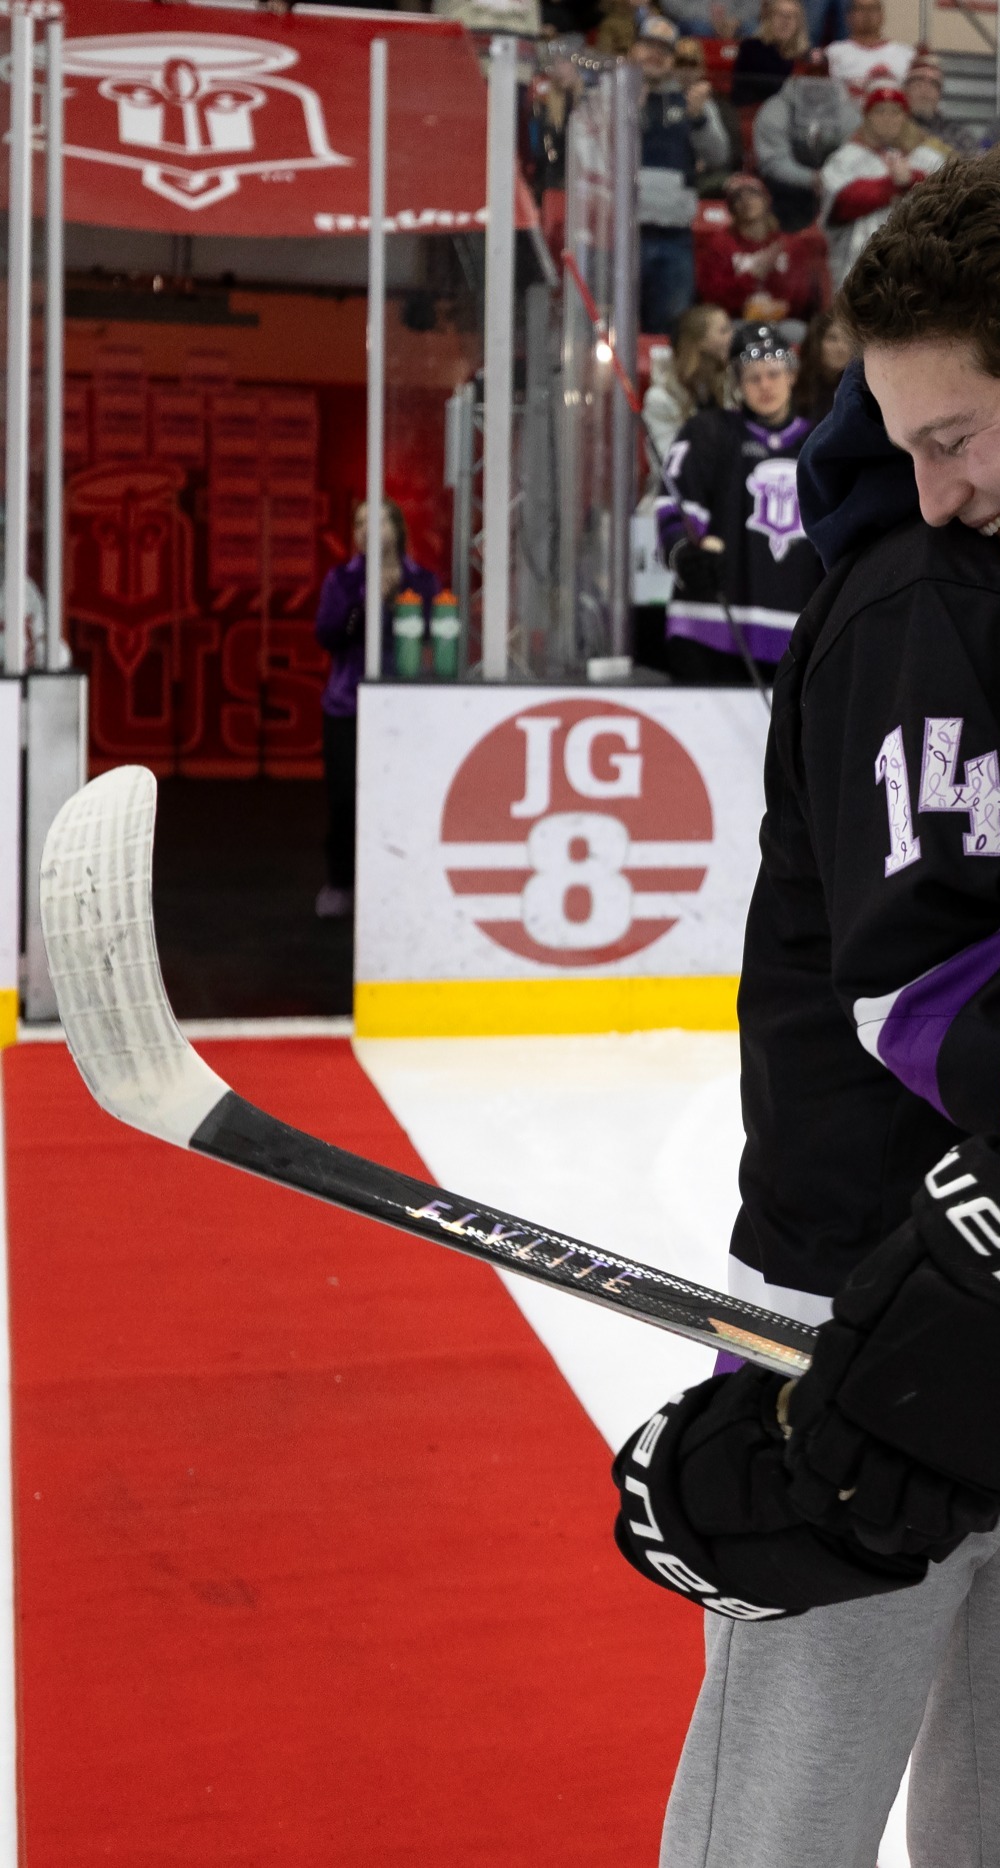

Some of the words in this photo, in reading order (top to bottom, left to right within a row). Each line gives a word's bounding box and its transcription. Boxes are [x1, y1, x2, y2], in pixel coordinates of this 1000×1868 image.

[511, 715, 643, 818] JG
[521, 811, 636, 950] 8
[625, 1393, 787, 1621] BAUE
